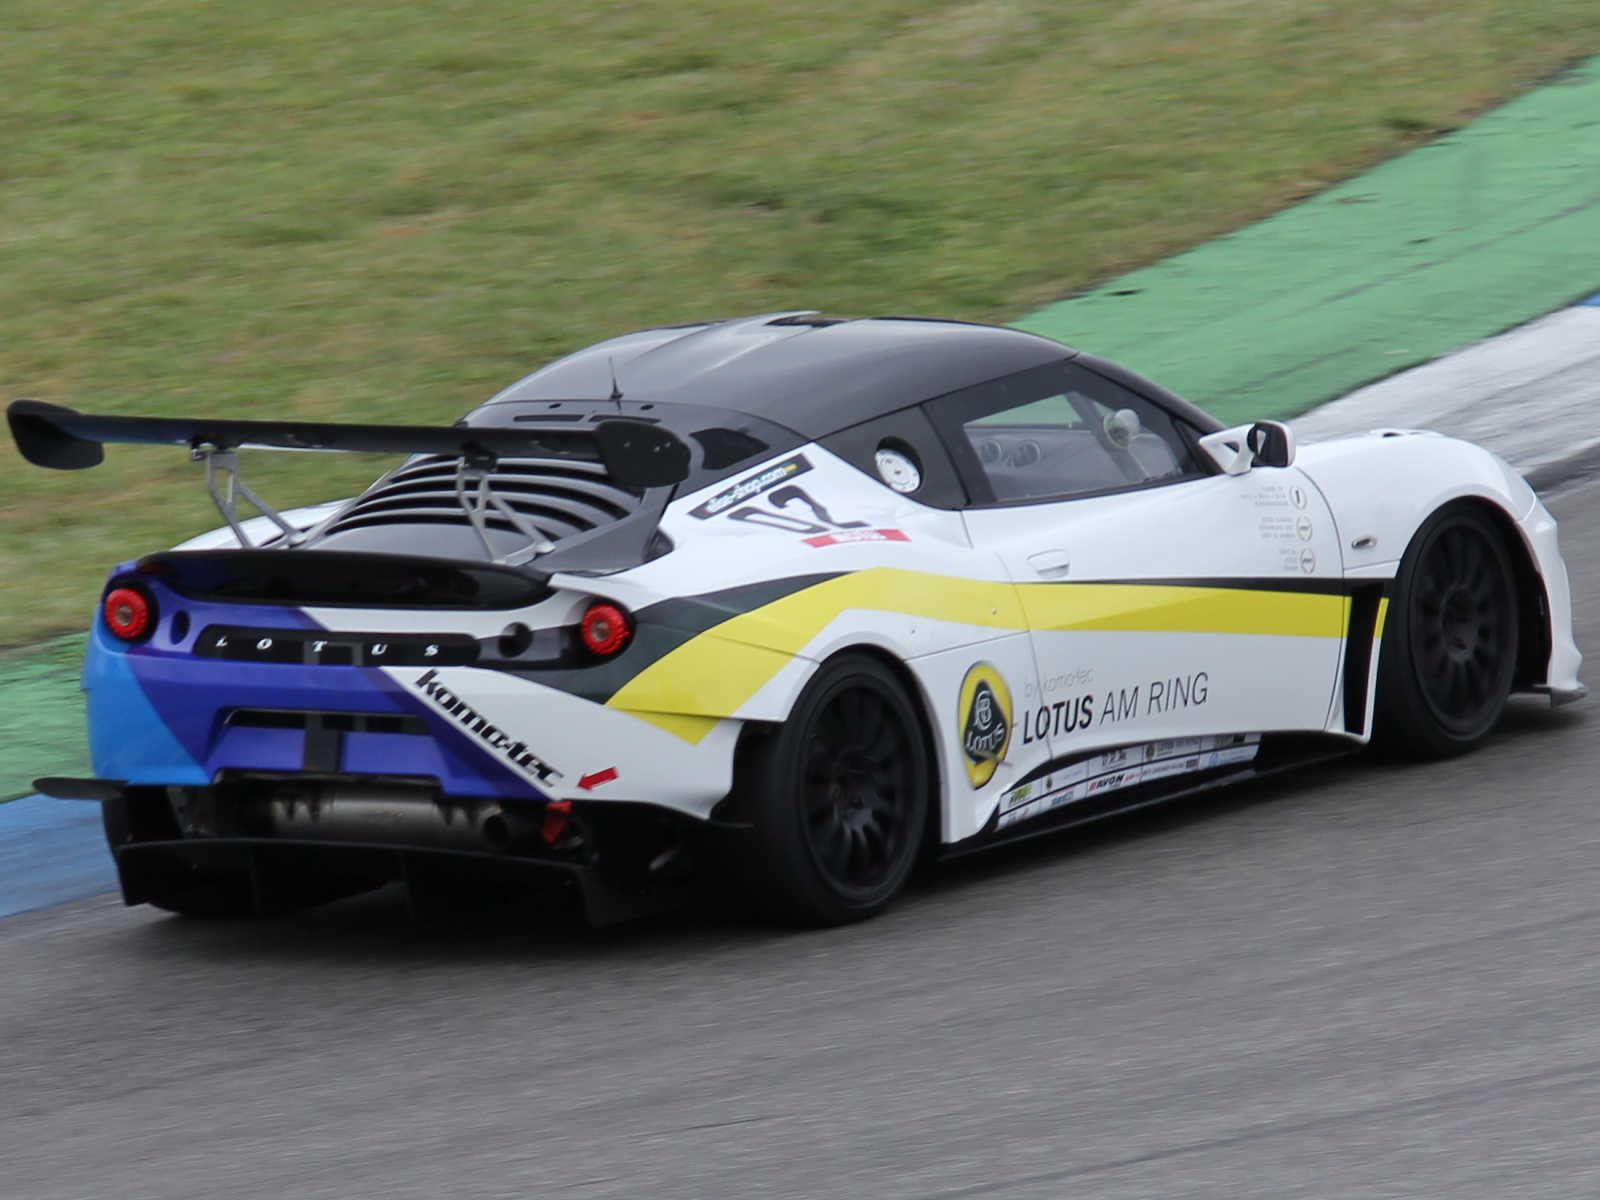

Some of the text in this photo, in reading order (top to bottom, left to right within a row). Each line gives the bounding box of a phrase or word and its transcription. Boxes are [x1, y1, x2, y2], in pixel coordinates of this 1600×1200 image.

[215, 635, 439, 657] LOTUS
[1025, 675, 1041, 698] by
[1023, 671, 1208, 745] LOTUS AM RING
[965, 722, 1005, 752] LOTUS
[1096, 773, 1125, 789] AVON
